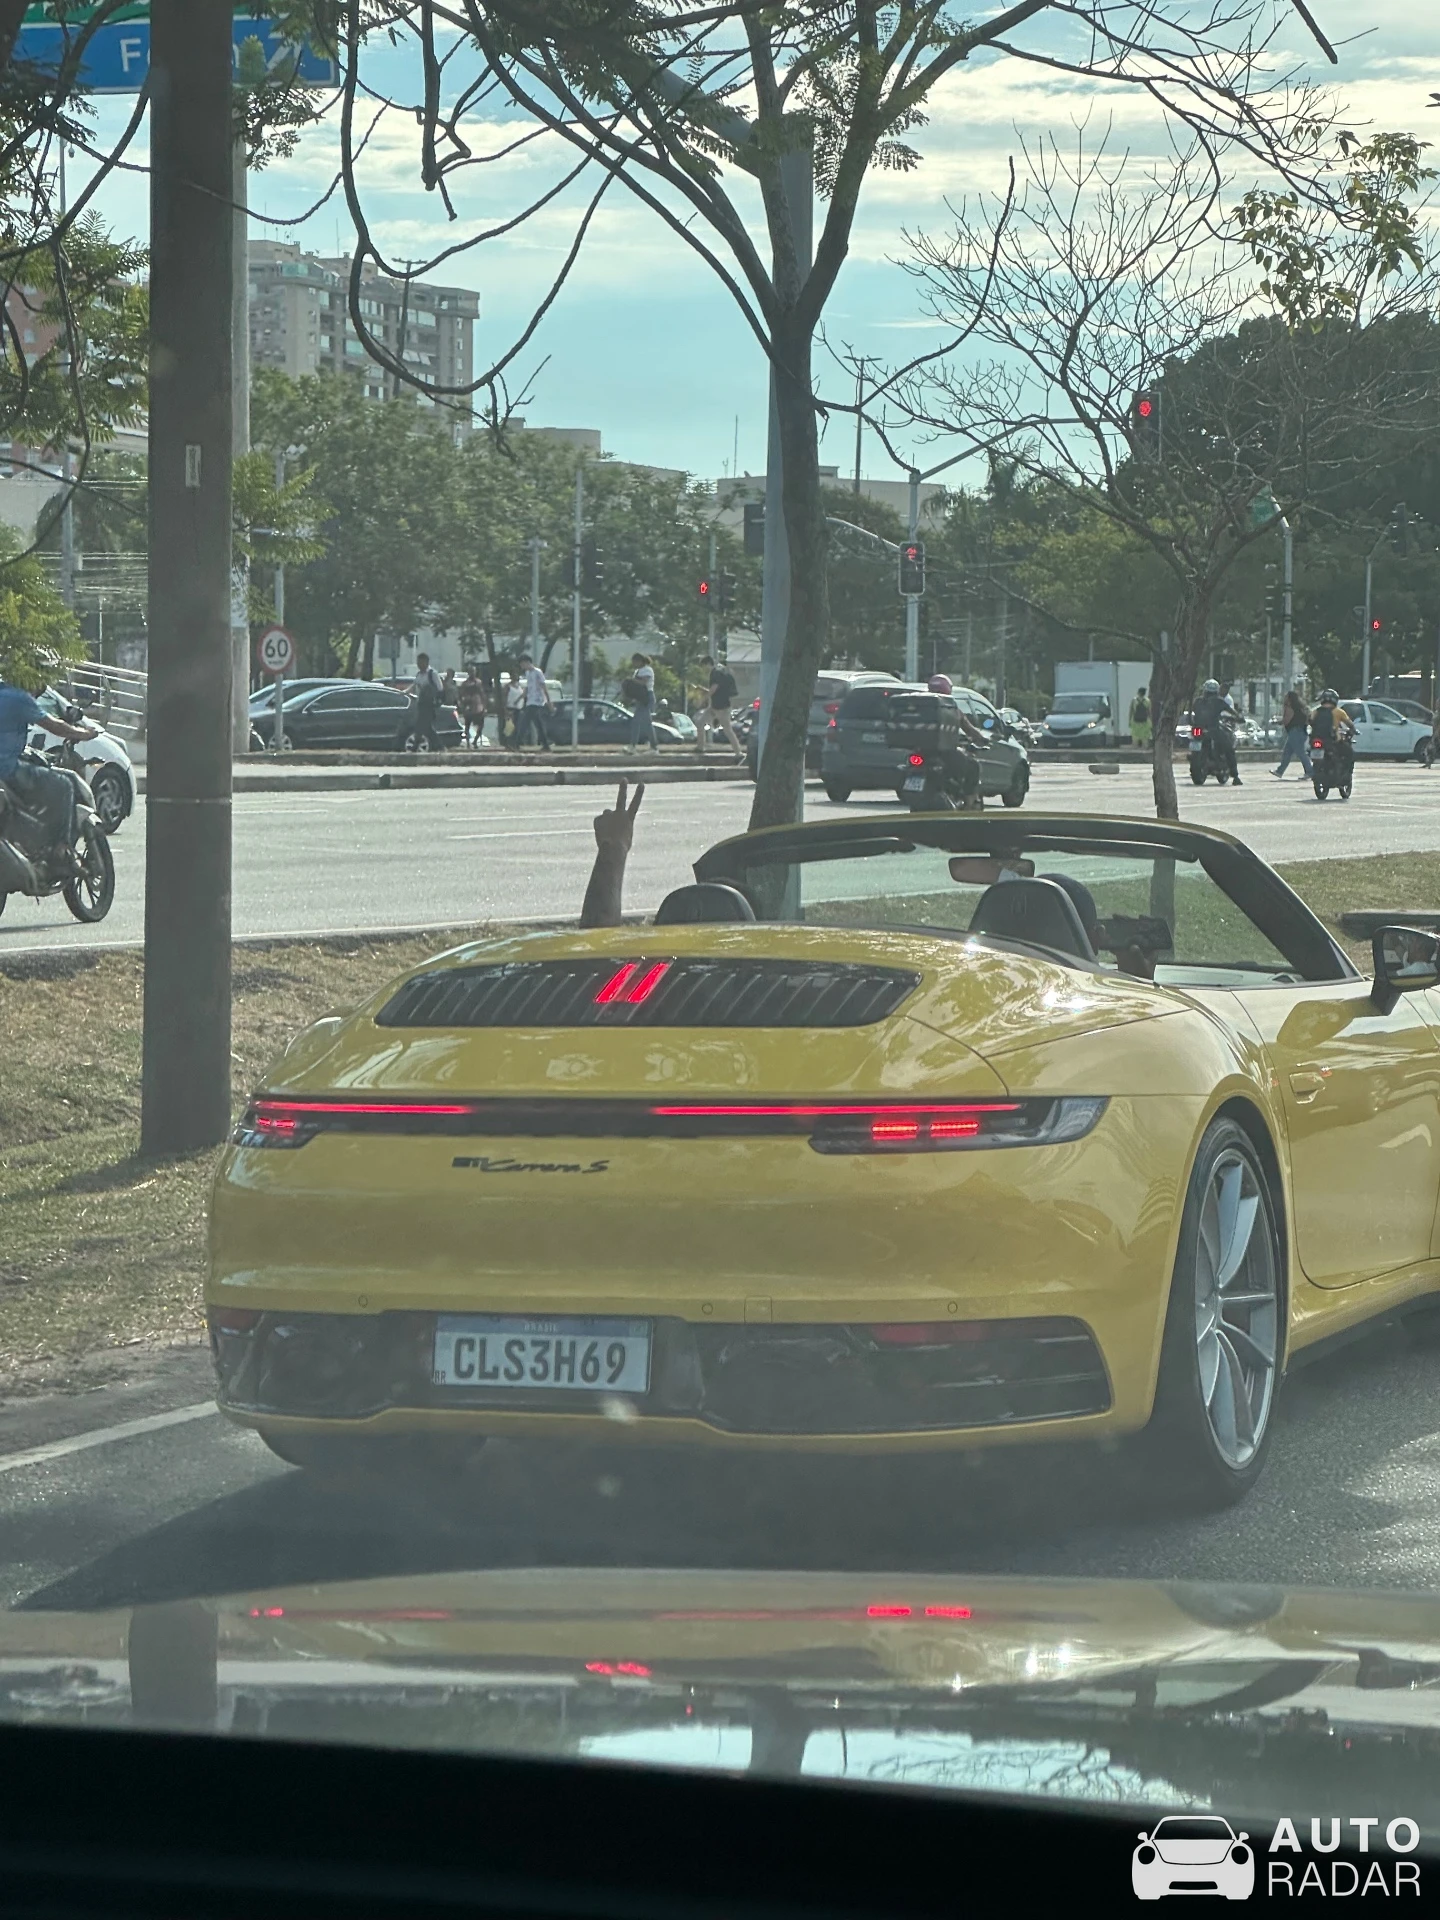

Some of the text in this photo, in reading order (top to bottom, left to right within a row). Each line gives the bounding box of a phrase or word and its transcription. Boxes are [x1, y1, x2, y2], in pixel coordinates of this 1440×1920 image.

[265, 638, 289, 658] 60
[480, 1159, 581, 1173] Carrera
[582, 1159, 610, 1174] S
[454, 1337, 626, 1384] CLS3H69
